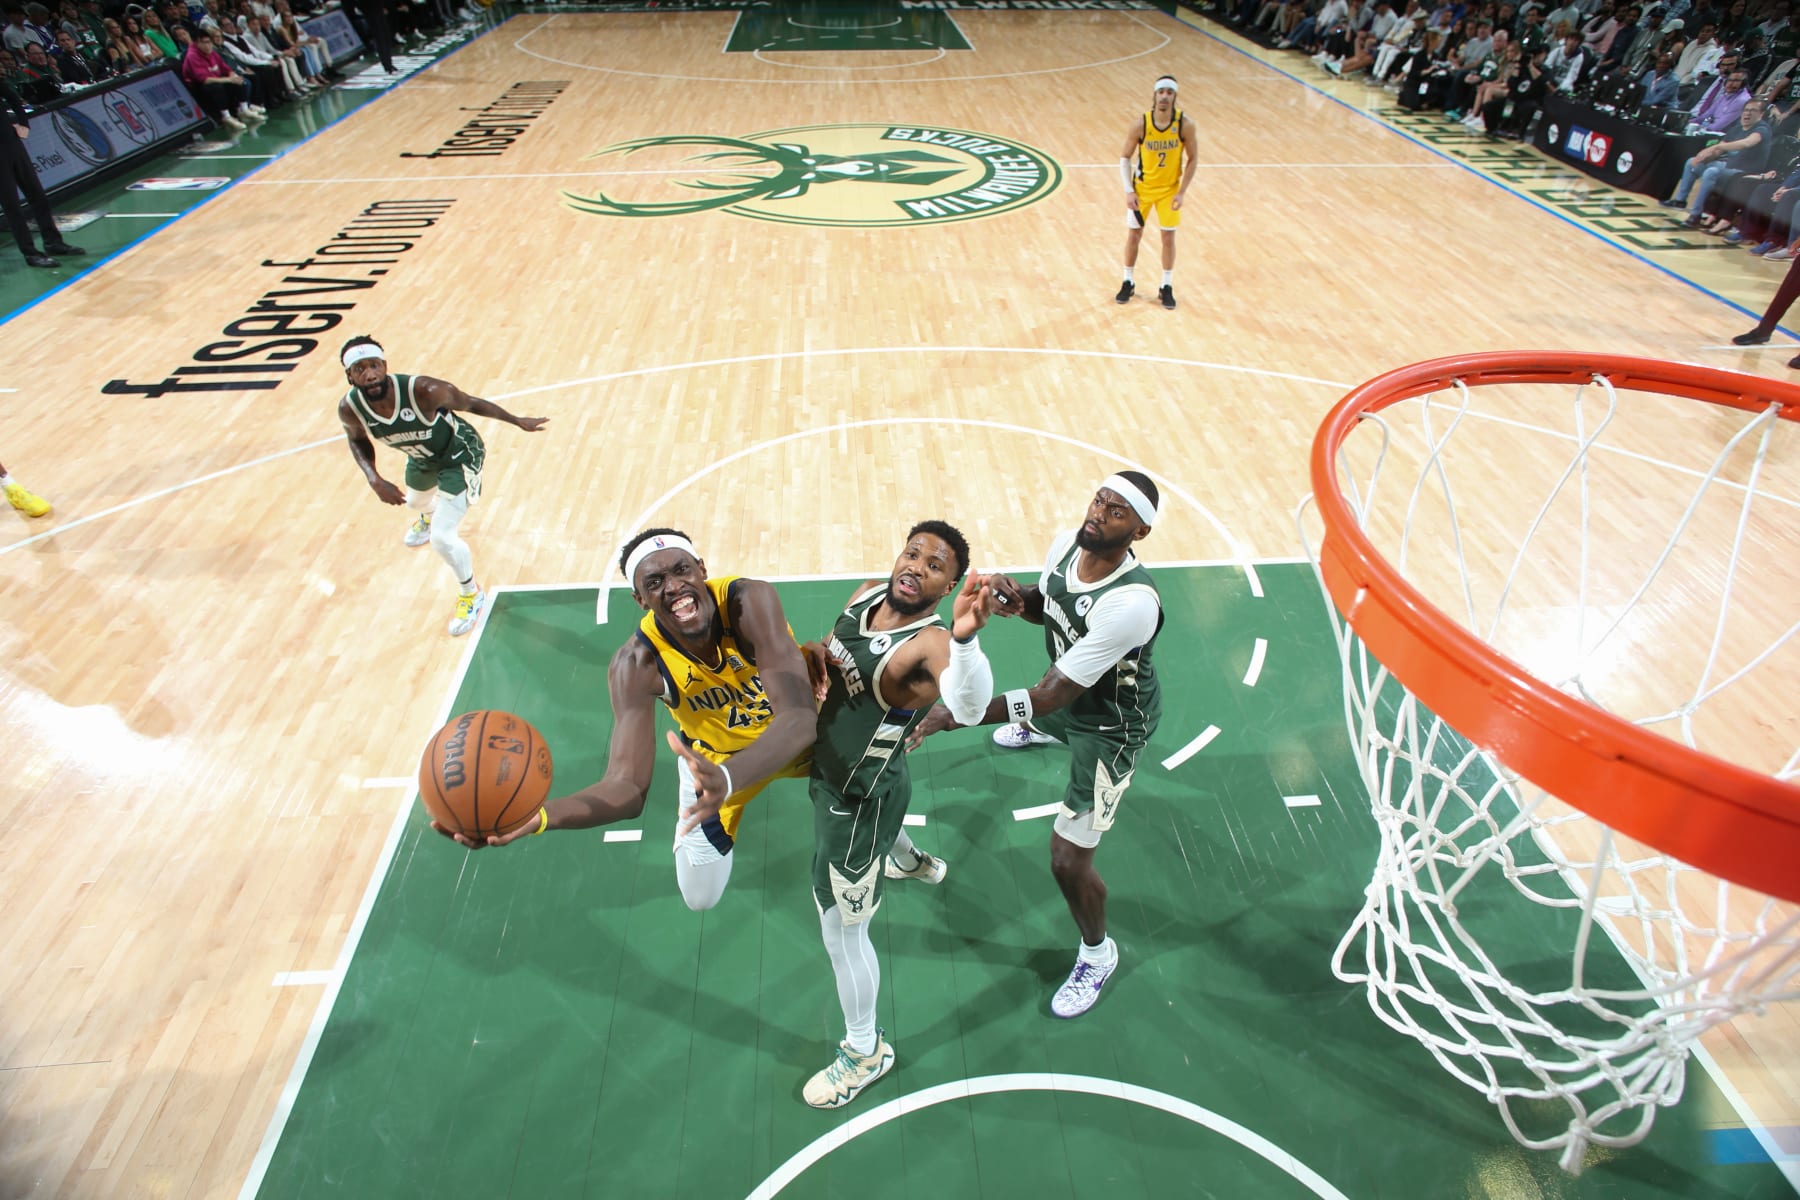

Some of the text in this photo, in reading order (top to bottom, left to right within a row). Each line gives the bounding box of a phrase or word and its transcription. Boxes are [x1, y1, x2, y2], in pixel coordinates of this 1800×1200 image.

[1144, 139, 1179, 151] INDIANA
[1158, 152, 1167, 167] 2
[888, 128, 1040, 217] MILWAUKEE BUCKS
[1449, 149, 1582, 183] THE
[1528, 188, 1745, 250] FEAR
[400, 444, 434, 458] 21
[727, 698, 774, 730] 43
[1014, 702, 1026, 717] BP
[443, 712, 479, 791] Wilson
